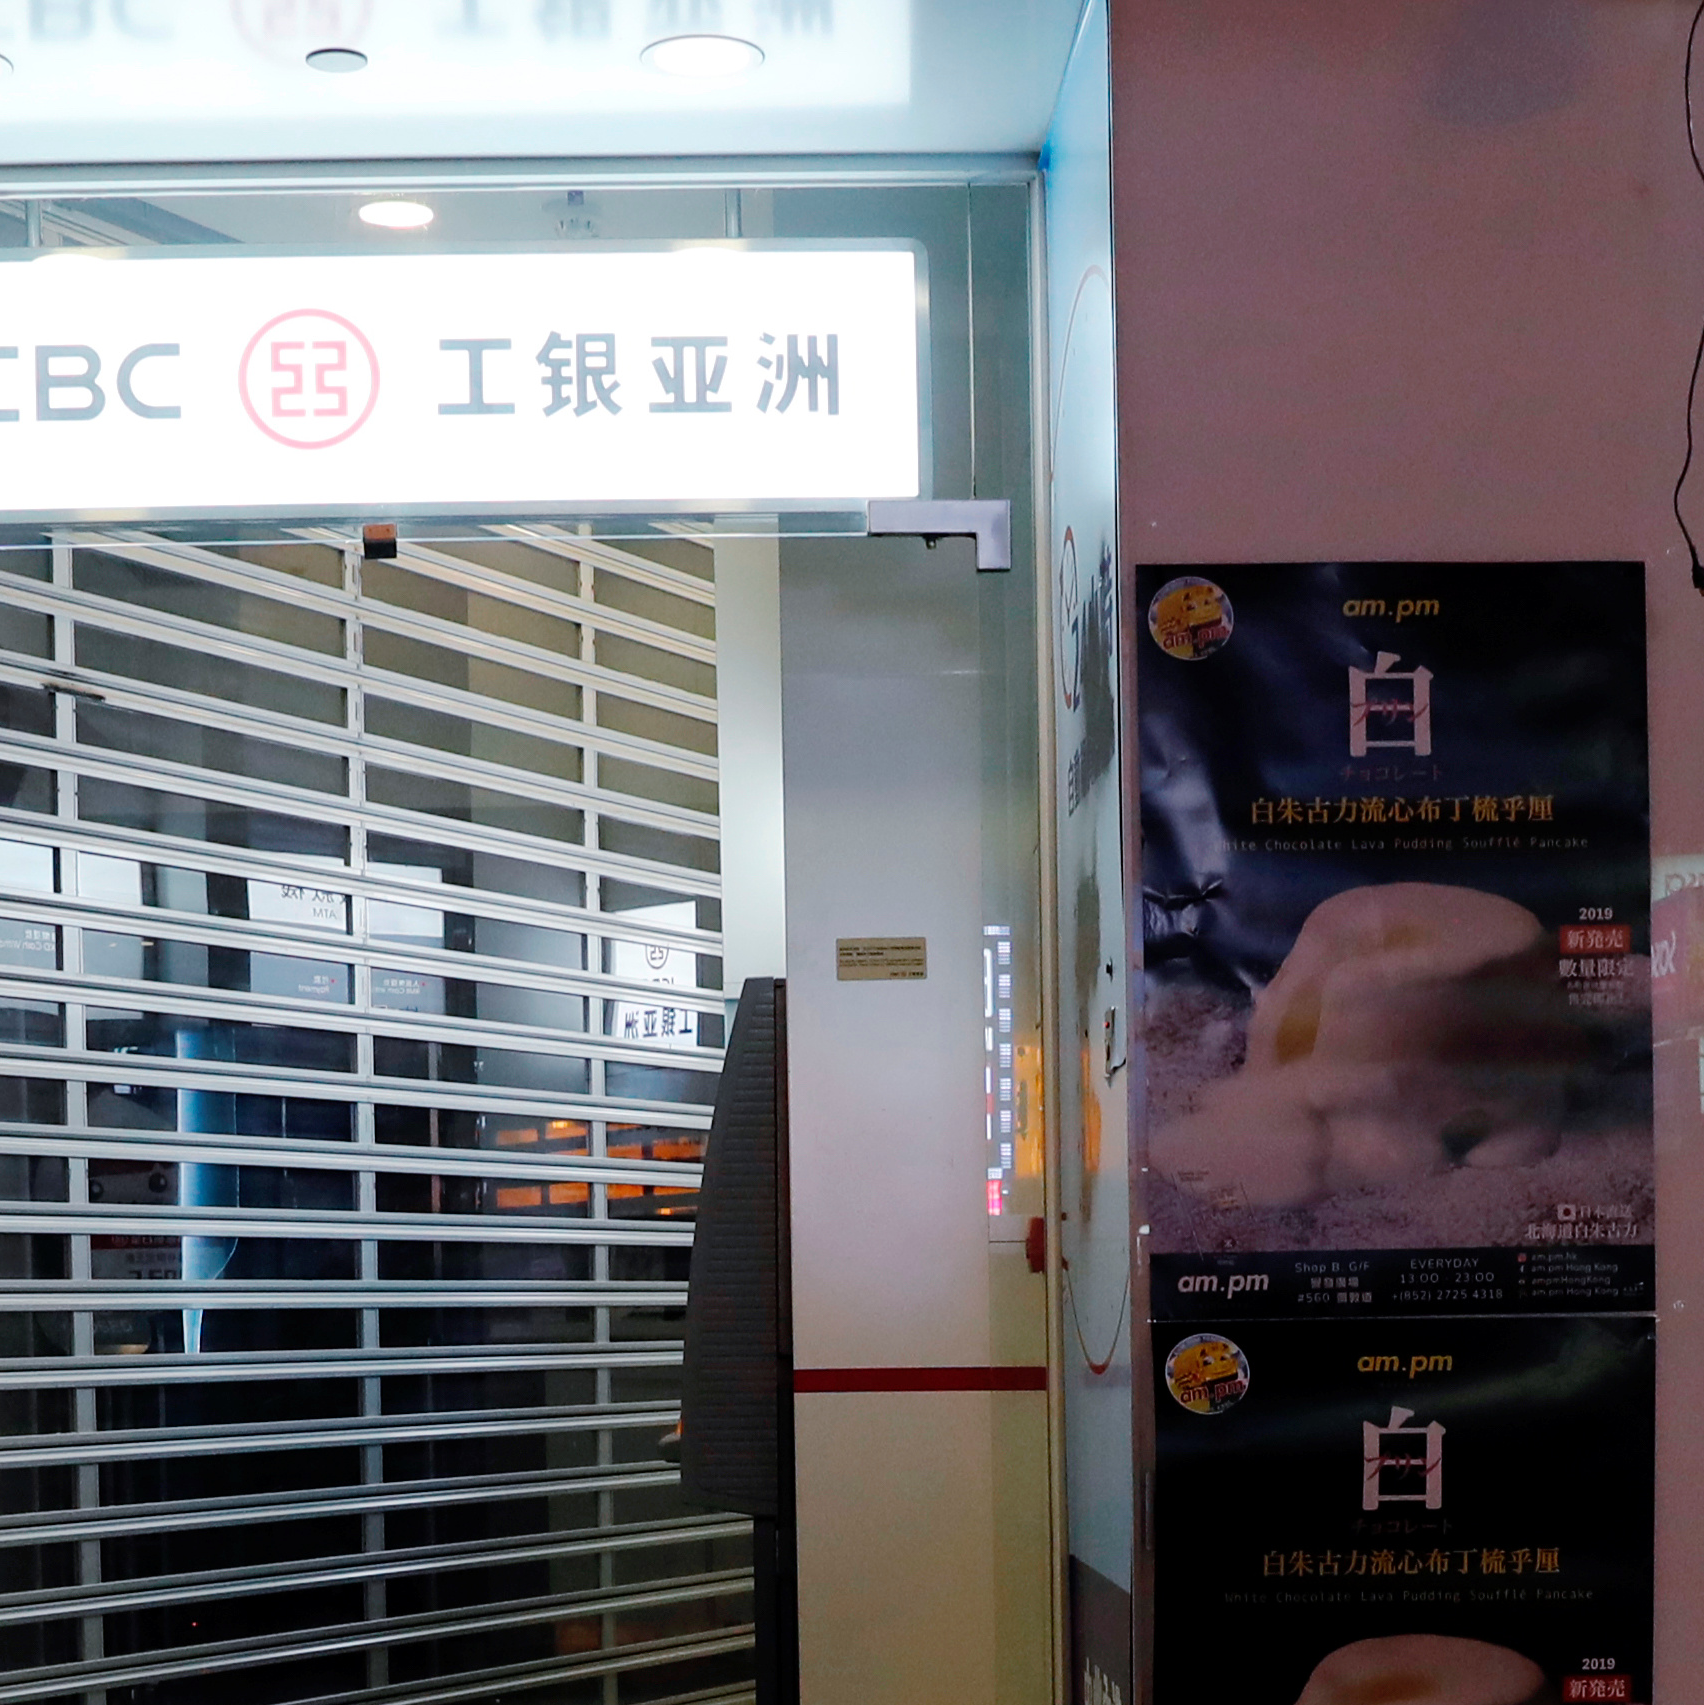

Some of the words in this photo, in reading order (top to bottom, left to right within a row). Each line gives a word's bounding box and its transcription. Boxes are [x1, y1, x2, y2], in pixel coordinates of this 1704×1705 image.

[436, 330, 840, 420] 工银亚洲
[1342, 597, 1440, 622] am.pm
[1348, 651, 1434, 757] 白
[1265, 836, 1342, 852] Chocolate
[1350, 836, 1385, 850] Lava
[1394, 836, 1452, 852] Pudding
[1530, 834, 1588, 848] Pancake
[1579, 907, 1613, 920] 2019
[1559, 958, 1634, 977] 數量限定
[1295, 1262, 1326, 1274] Shop
[1410, 1258, 1479, 1270] EVERYDAY
[1177, 1274, 1270, 1300] am.pm
[1436, 1289, 1468, 1300] 2725
[1472, 1288, 1503, 1300] 4318
[1357, 1353, 1453, 1379] am.pm
[1362, 1405, 1447, 1510] 白
[1262, 1547, 1559, 1577] 白朱古力流心布丁梳乎厘
[1276, 1589, 1351, 1605] Chocolate
[1360, 1590, 1394, 1603] Lava
[1403, 1589, 1461, 1605] Pudding
[1536, 1587, 1594, 1602] Pancake
[1582, 1657, 1616, 1671] 2019
[1569, 1679, 1625, 1698] 新発売
